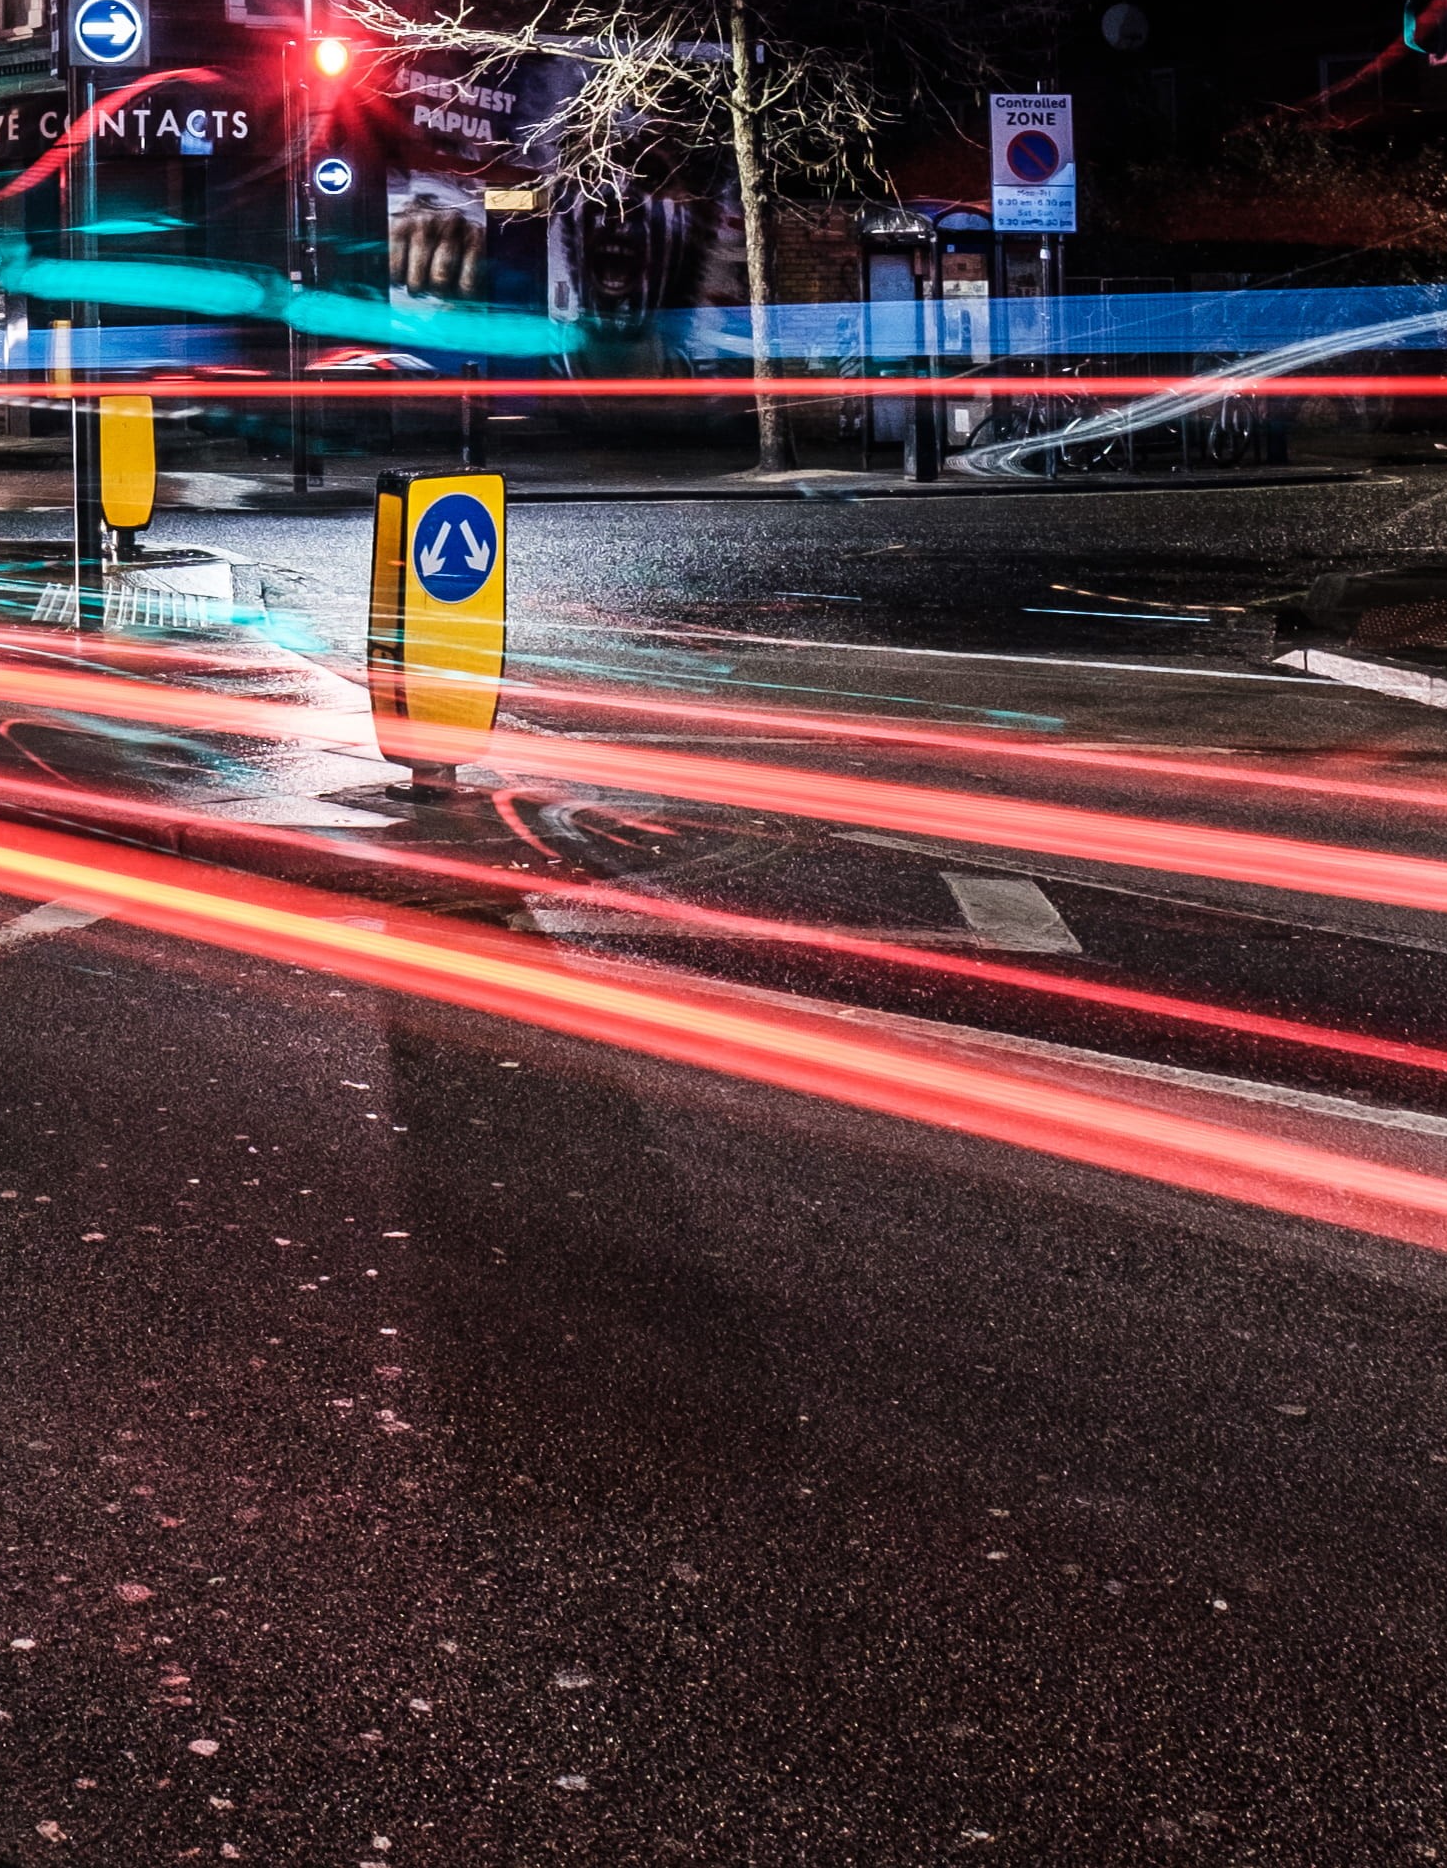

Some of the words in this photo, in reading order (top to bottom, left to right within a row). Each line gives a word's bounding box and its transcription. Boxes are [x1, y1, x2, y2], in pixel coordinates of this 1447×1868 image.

[396, 69, 453, 100] FREE
[459, 85, 517, 114] WEST
[995, 97, 1067, 109] Controlled
[39, 109, 248, 139] CNTACTS
[414, 105, 493, 141] PAPUA
[1006, 112, 1056, 126] ZONE
